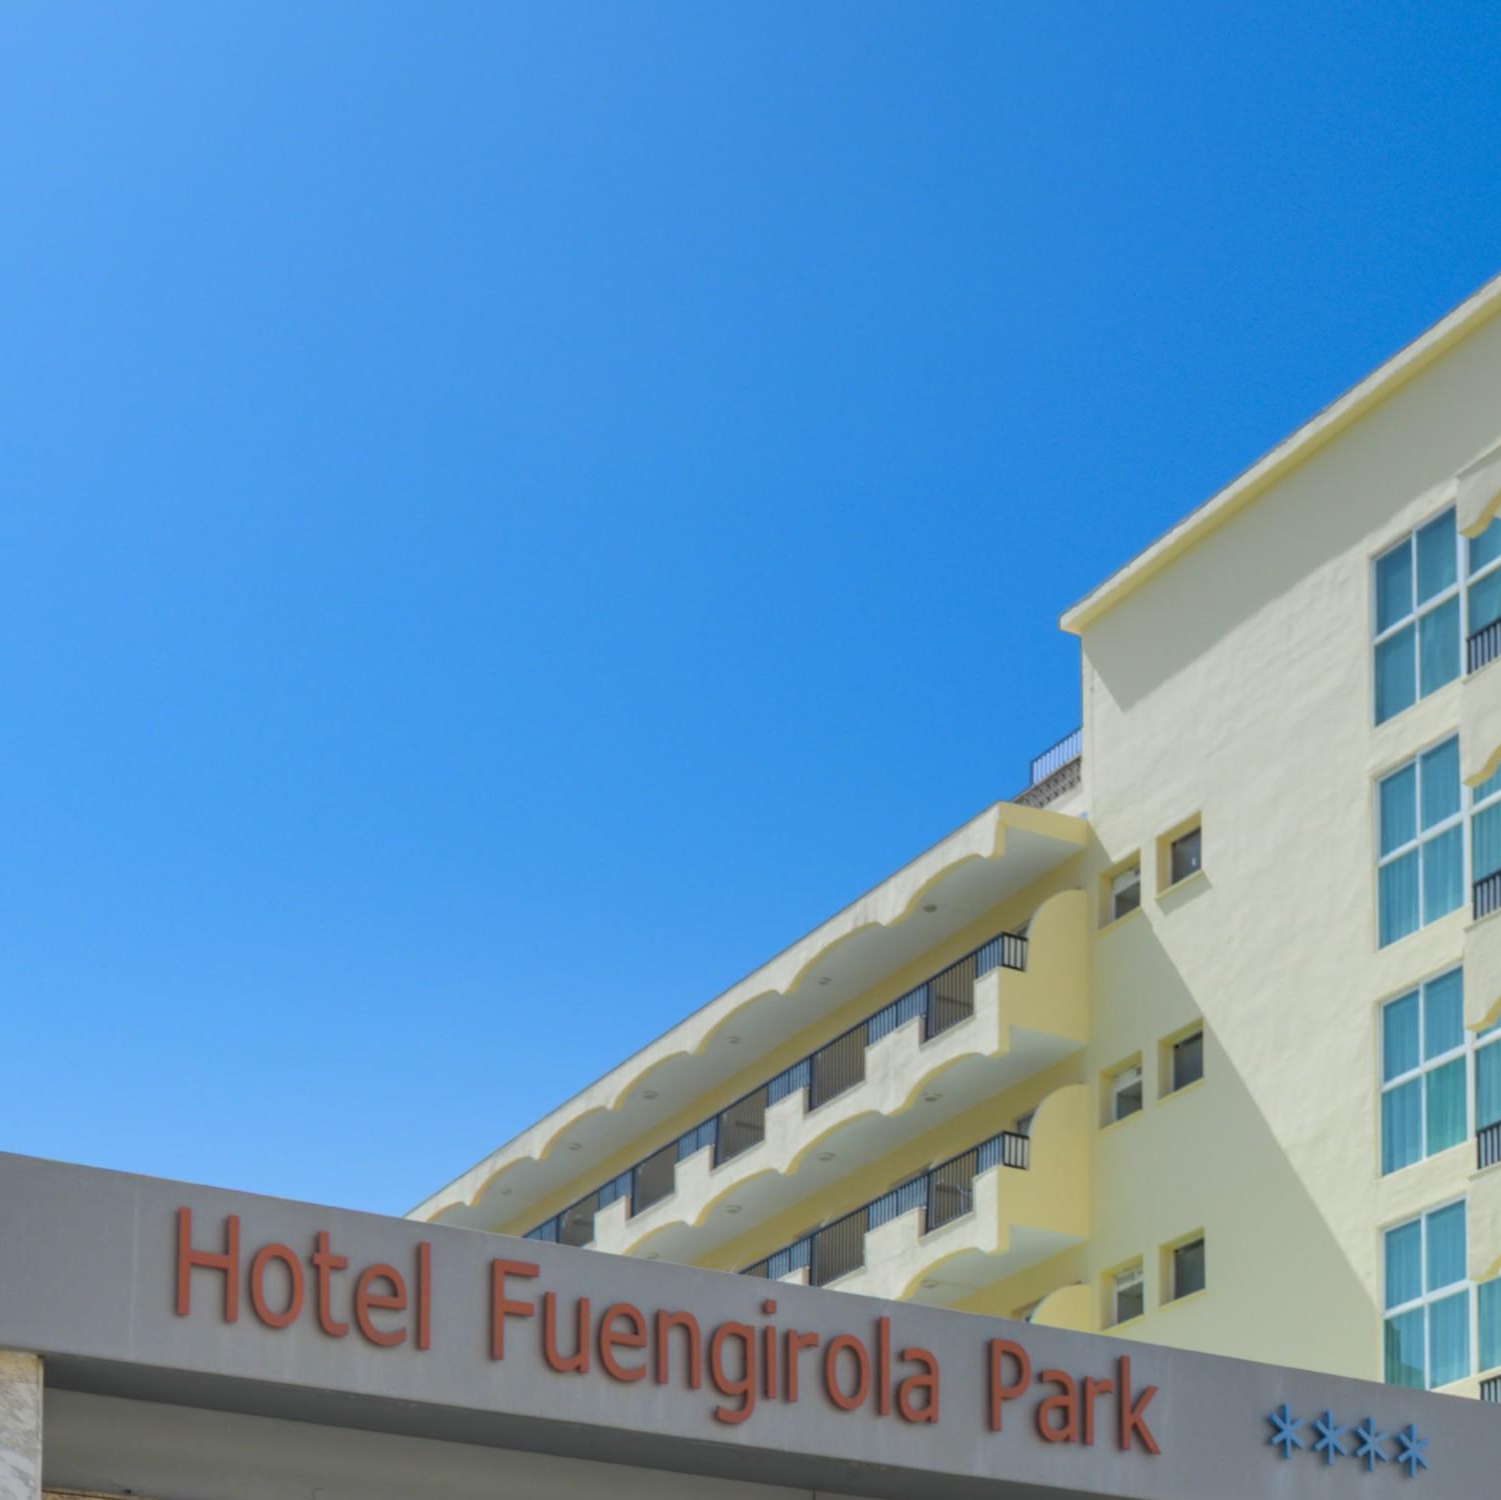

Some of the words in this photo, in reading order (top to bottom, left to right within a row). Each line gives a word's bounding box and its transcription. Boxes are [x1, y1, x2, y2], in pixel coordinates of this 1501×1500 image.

[177, 1207, 430, 1350] Hotel
[492, 1259, 939, 1424] Fuengirola
[991, 1339, 1158, 1455] Park
